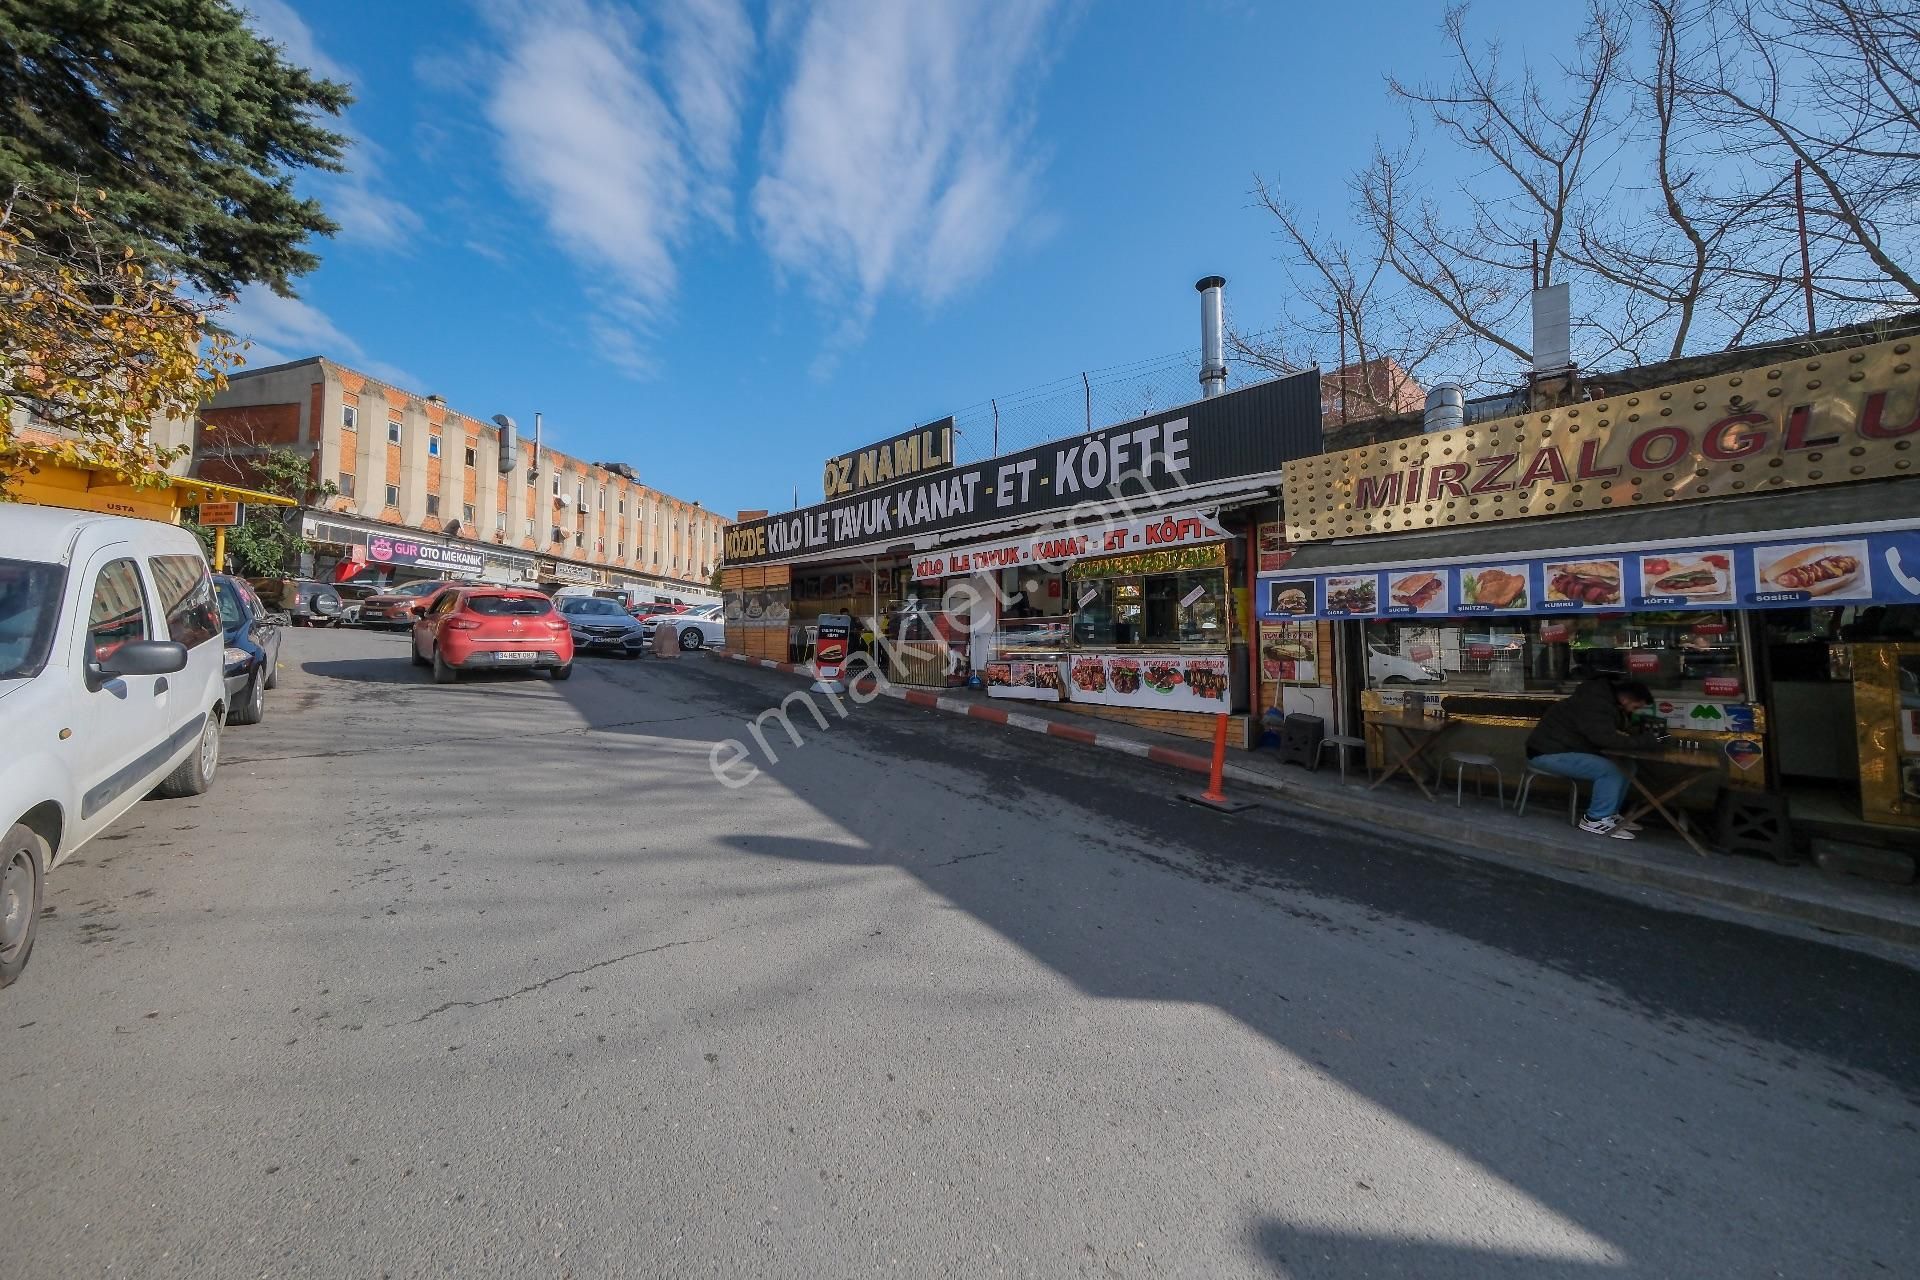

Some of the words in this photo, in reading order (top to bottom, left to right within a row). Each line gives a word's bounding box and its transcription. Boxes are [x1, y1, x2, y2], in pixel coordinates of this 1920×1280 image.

[823, 456, 852, 496] ÖZ
[858, 428, 951, 488] NAMLI
[107, 503, 135, 513] USTA
[725, 523, 766, 560] KÖZDE
[768, 519, 802, 554] KİLO
[804, 511, 829, 548] İLE
[831, 496, 892, 542] TAVUK
[897, 471, 981, 528] KANAT
[997, 458, 1037, 508] ET
[1055, 416, 1190, 496] KÖFTE
[420, 546, 440, 560] OTO
[916, 557, 944, 577] KİLO
[949, 553, 970, 572] İLE
[973, 546, 1020, 569] TAVUK
[1031, 536, 1089, 561] KANAT
[1103, 529, 1129, 551] ET
